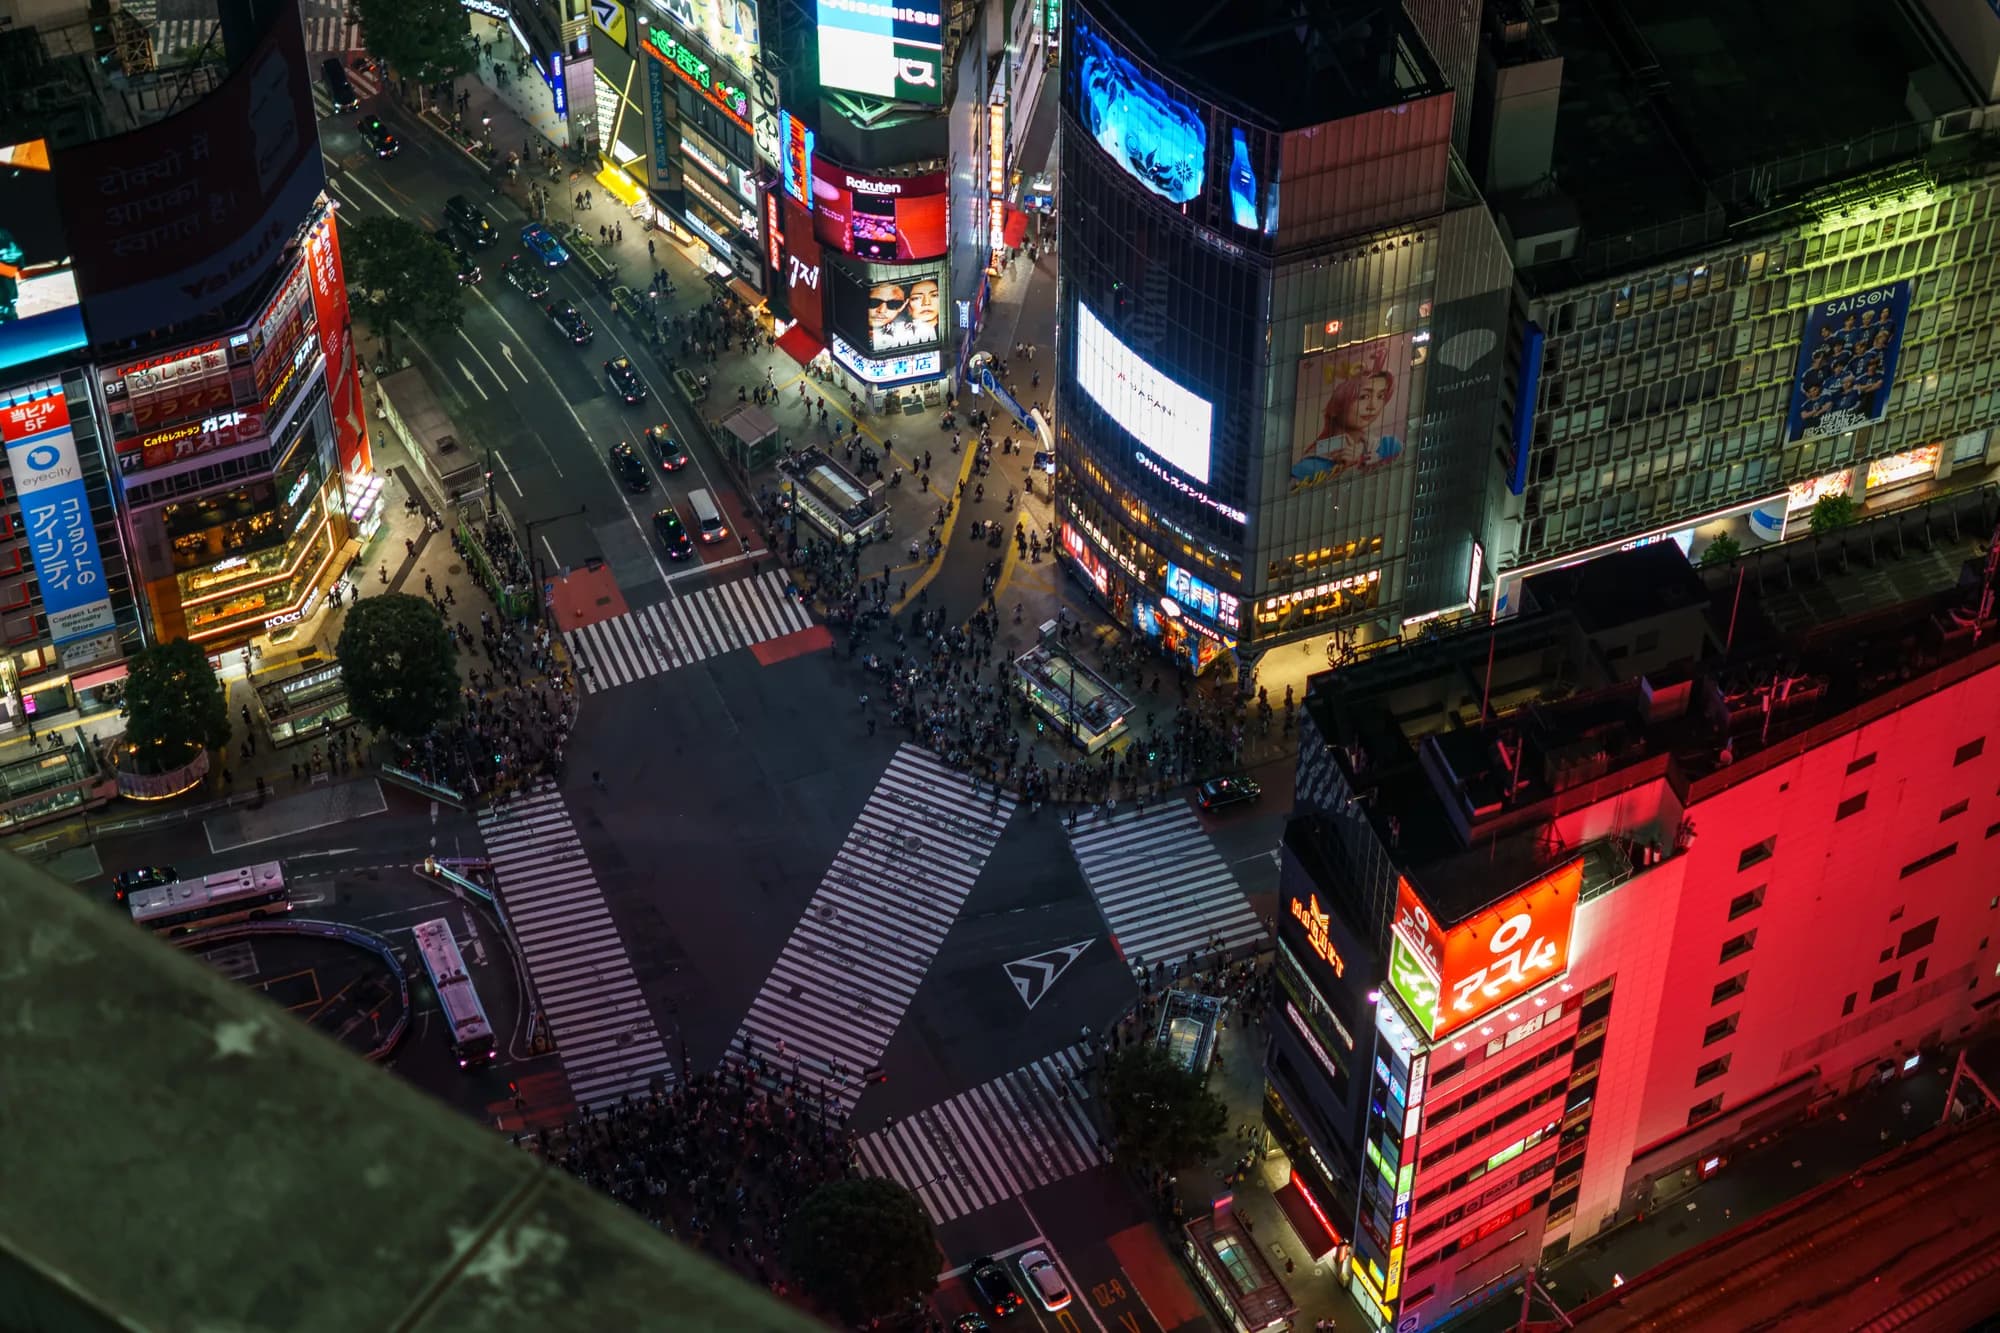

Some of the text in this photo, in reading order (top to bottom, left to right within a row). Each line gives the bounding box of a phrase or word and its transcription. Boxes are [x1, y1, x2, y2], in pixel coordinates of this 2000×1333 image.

[846, 175, 901, 194] Rakuten
[1826, 286, 1896, 317] SAISON
[105, 380, 125, 395] 9F
[1436, 372, 1492, 395] TSUTAYA
[10, 402, 55, 423] 当ビル
[201, 411, 248, 434] ガスト
[24, 417, 48, 433] 5F
[175, 432, 231, 457] ガスト
[119, 453, 142, 469] 7F
[22, 465, 73, 488] eyecity
[29, 503, 73, 591] アイシティ
[61, 497, 97, 586] コンタクトの
[1071, 502, 1147, 582] STARBUCKS
[1266, 570, 1379, 610] STARBUCKS
[52, 610, 85, 625] Contact
[1183, 616, 1220, 641] TSUTAYA
[1453, 936, 1557, 1012] アコム
